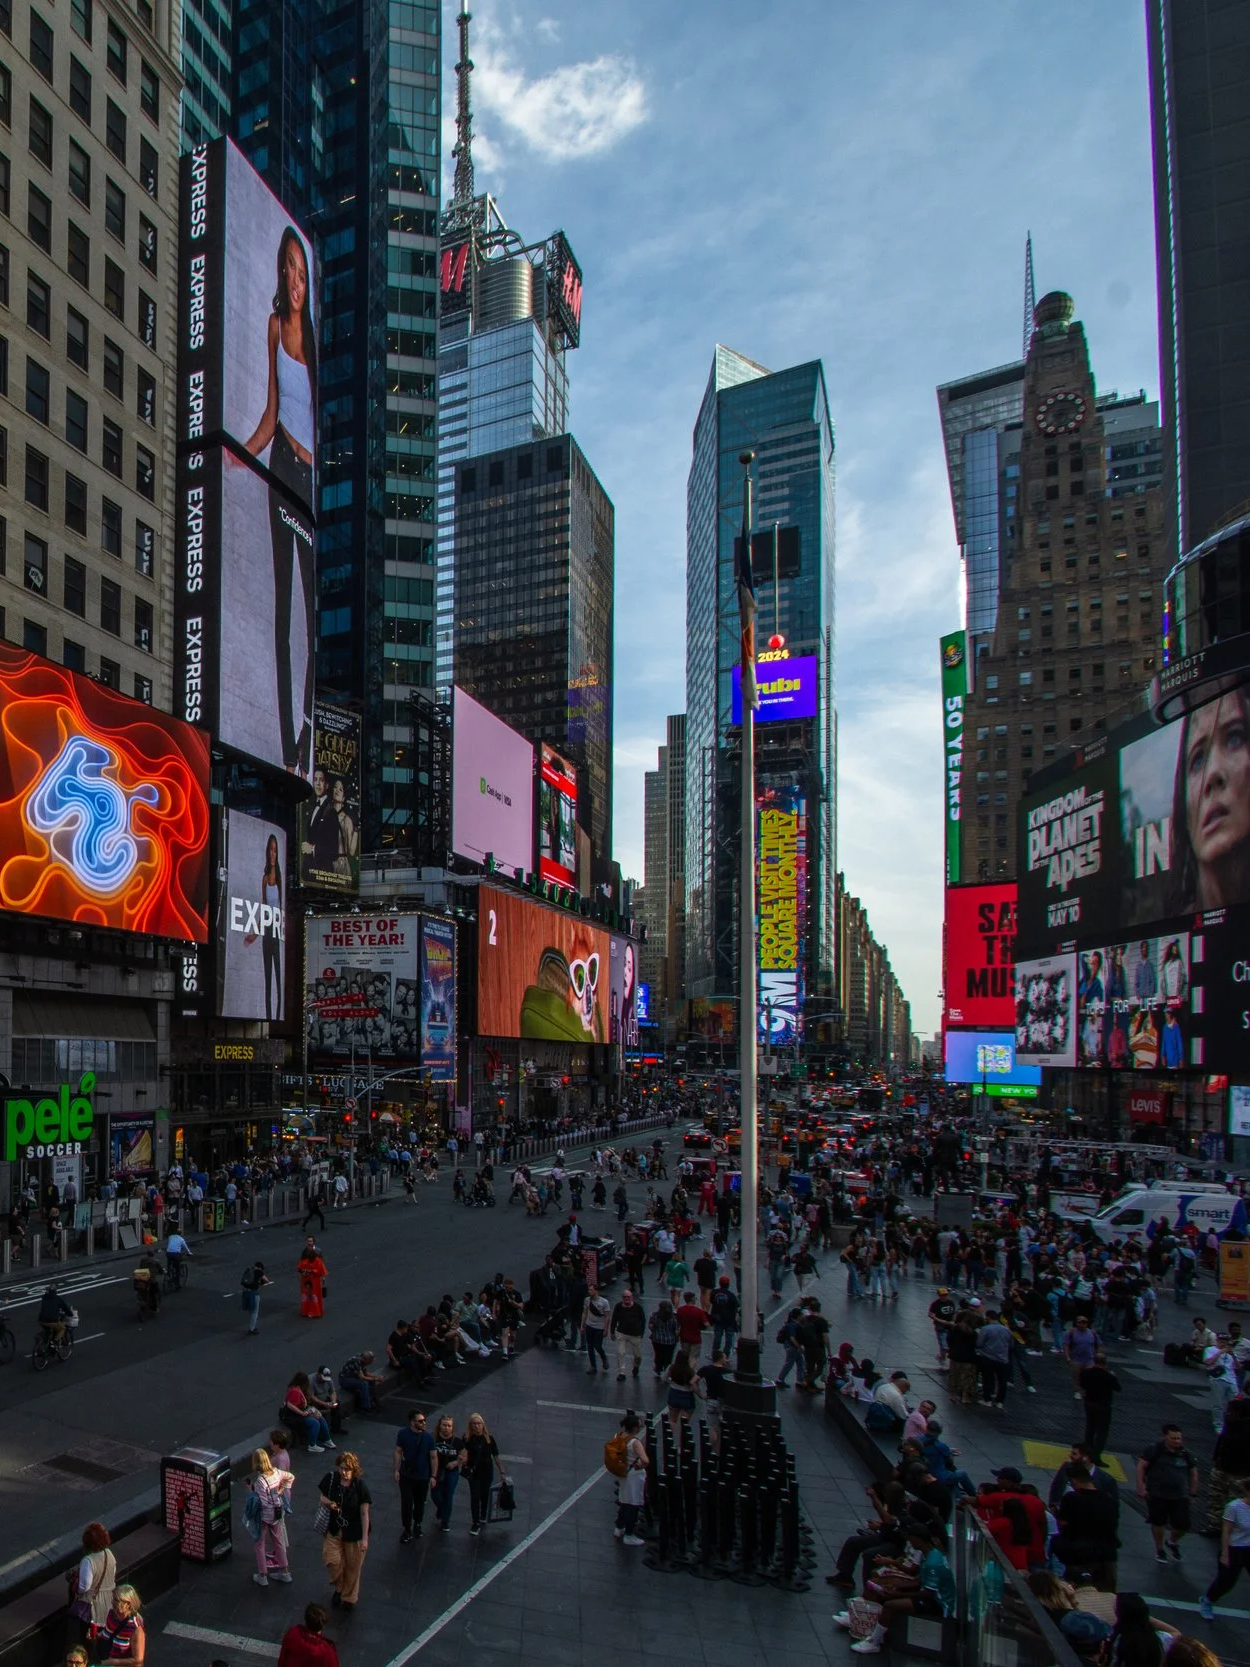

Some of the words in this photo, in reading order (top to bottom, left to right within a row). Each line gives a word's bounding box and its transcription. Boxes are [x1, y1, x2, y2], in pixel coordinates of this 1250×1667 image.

[189, 254, 206, 351] EXPRESS
[186, 486, 204, 593] EXPRESS
[185, 617, 202, 722] EXPRESS
[757, 649, 789, 663] 2024
[946, 696, 964, 728] 50
[946, 733, 964, 822] YEARS
[1027, 785, 1086, 831] KINGDOM
[760, 809, 780, 859] TIMES
[1027, 800, 1106, 872] PLANET
[1135, 817, 1171, 879] IN
[760, 860, 779, 903] VISIT
[1046, 840, 1102, 893] APES
[330, 919, 373, 933] BEST
[376, 918, 399, 932] OF
[488, 909, 498, 946] 2
[760, 903, 780, 970] PEOPLE
[778, 898, 797, 969] SQUARE
[1047, 908, 1068, 929] MAY
[1068, 903, 1081, 924] 10
[322, 934, 354, 947] THE
[358, 933, 405, 947] YEAR!
[214, 1045, 254, 1060] EXPRESS
[1000, 1087, 1021, 1095] NEW
[5, 1071, 97, 1161] pelé
[26, 1141, 83, 1159] SOCCER
[1187, 1208, 1230, 1219] smart
